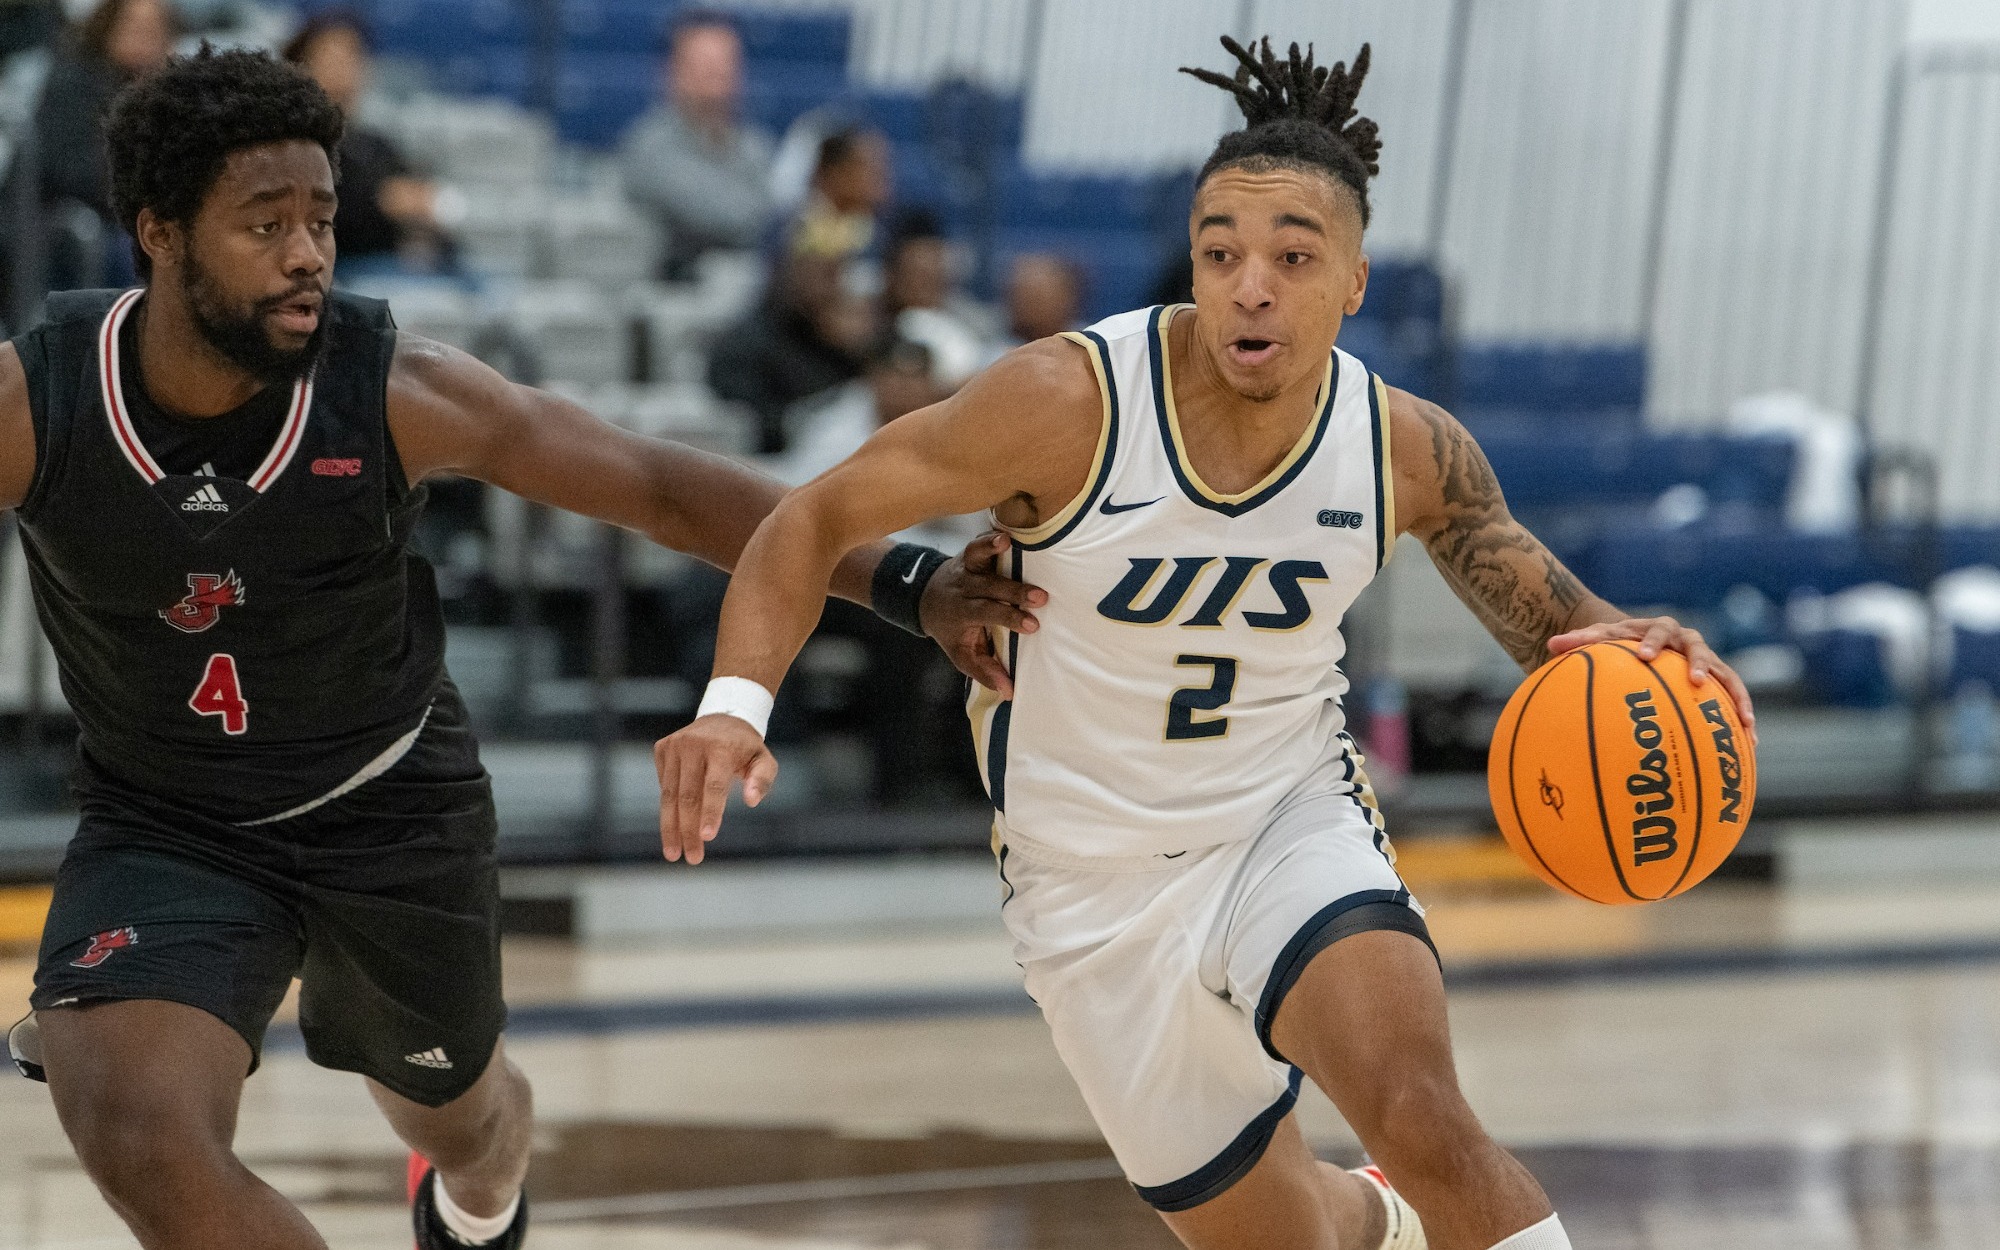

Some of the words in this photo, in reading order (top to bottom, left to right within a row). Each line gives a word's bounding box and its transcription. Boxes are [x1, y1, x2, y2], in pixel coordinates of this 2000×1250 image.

[181, 501, 229, 512] adidas
[1316, 509, 1363, 529] GLVC
[1096, 556, 1331, 633] UIS
[188, 653, 249, 735] 4
[1162, 654, 1241, 743] 2
[1624, 688, 1678, 867] Wilson
[1698, 699, 1742, 823] NCAA
[404, 1055, 453, 1069] adidas
